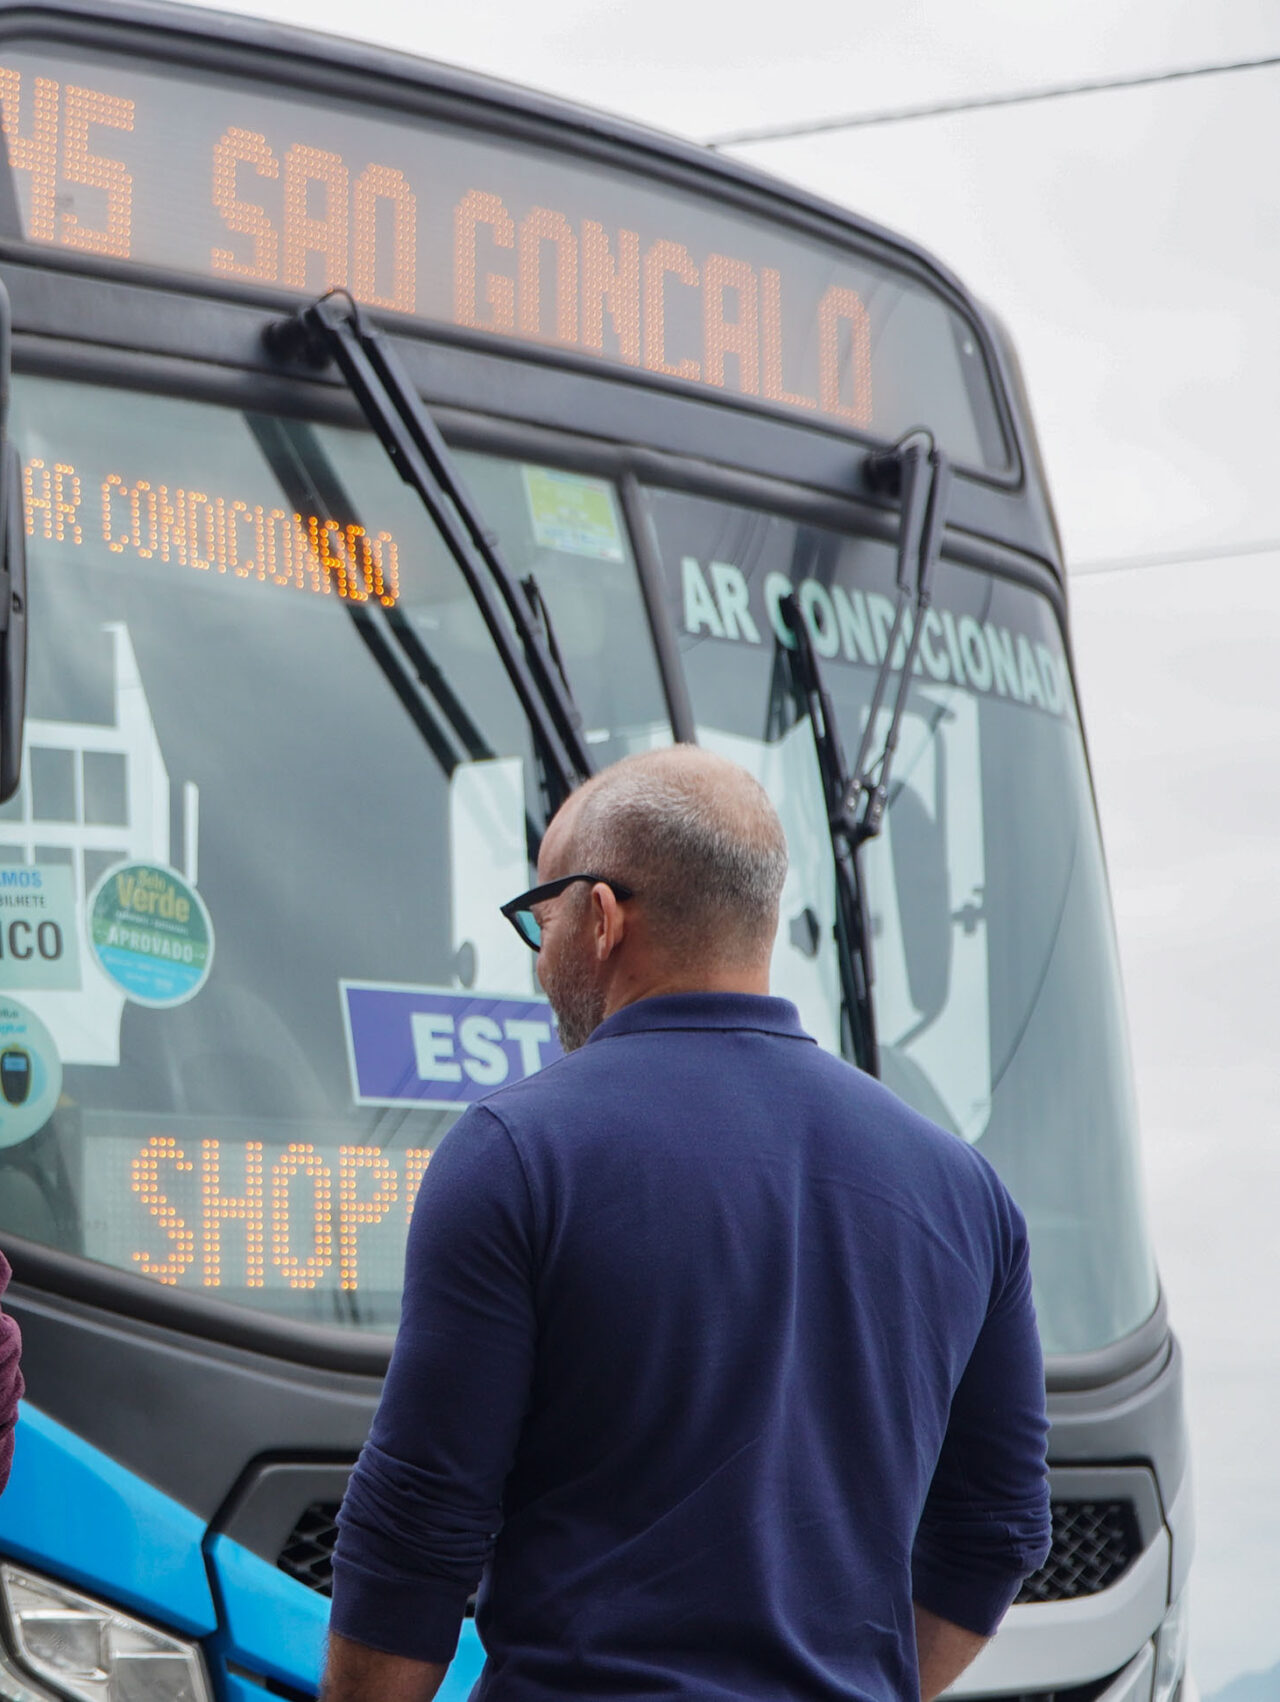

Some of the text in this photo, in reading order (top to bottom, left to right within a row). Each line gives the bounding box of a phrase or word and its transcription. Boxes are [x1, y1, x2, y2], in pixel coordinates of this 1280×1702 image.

[211, 126, 417, 314] SAO
[455, 189, 873, 430] GONCALO
[24, 458, 400, 608] AR CONDICIONADO
[680, 555, 1068, 720] AR CONDICIONAD
[107, 924, 194, 963] APROVADO
[116, 872, 191, 923] Verde
